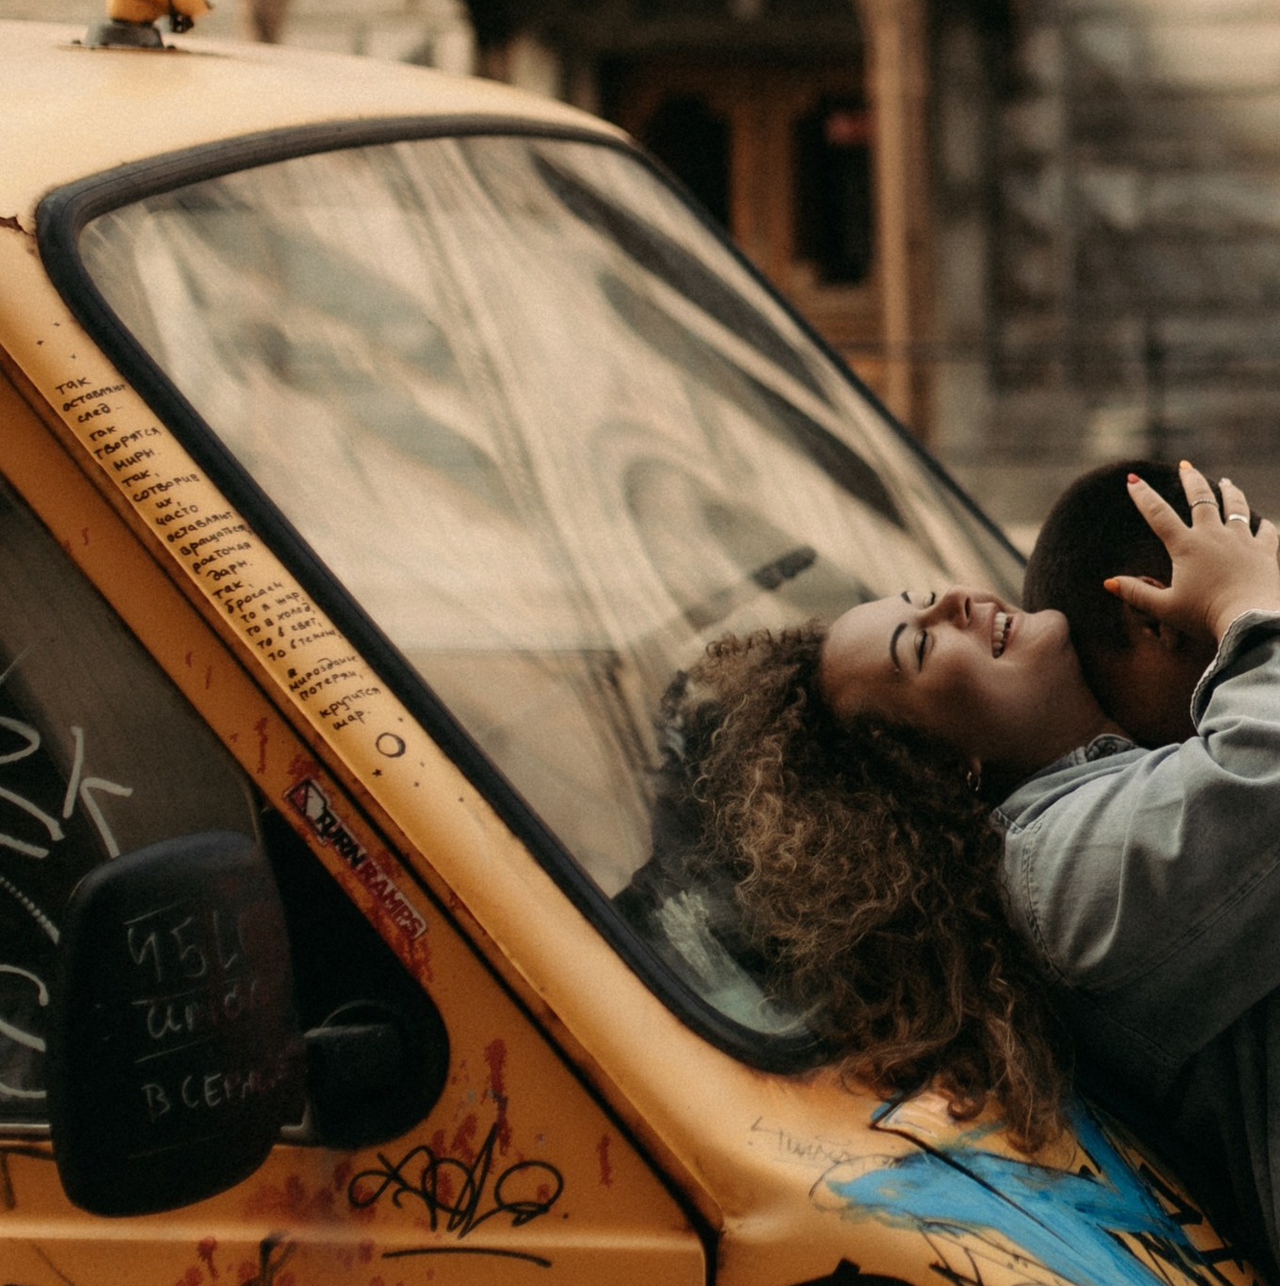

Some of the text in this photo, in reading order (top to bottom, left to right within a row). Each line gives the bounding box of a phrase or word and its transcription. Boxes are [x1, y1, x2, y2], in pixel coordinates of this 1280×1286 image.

[55, 377, 92, 395] так
[63, 384, 127, 412] оставляют
[94, 426, 160, 460] творятся
[133, 473, 201, 503] сотворив
[155, 504, 199, 526] часто
[167, 511, 233, 543] оставляют
[240, 611, 256, 624] то
[268, 649, 287, 661] то
[319, 687, 382, 719] крутится
[357, 859, 425, 941] RAMPS
